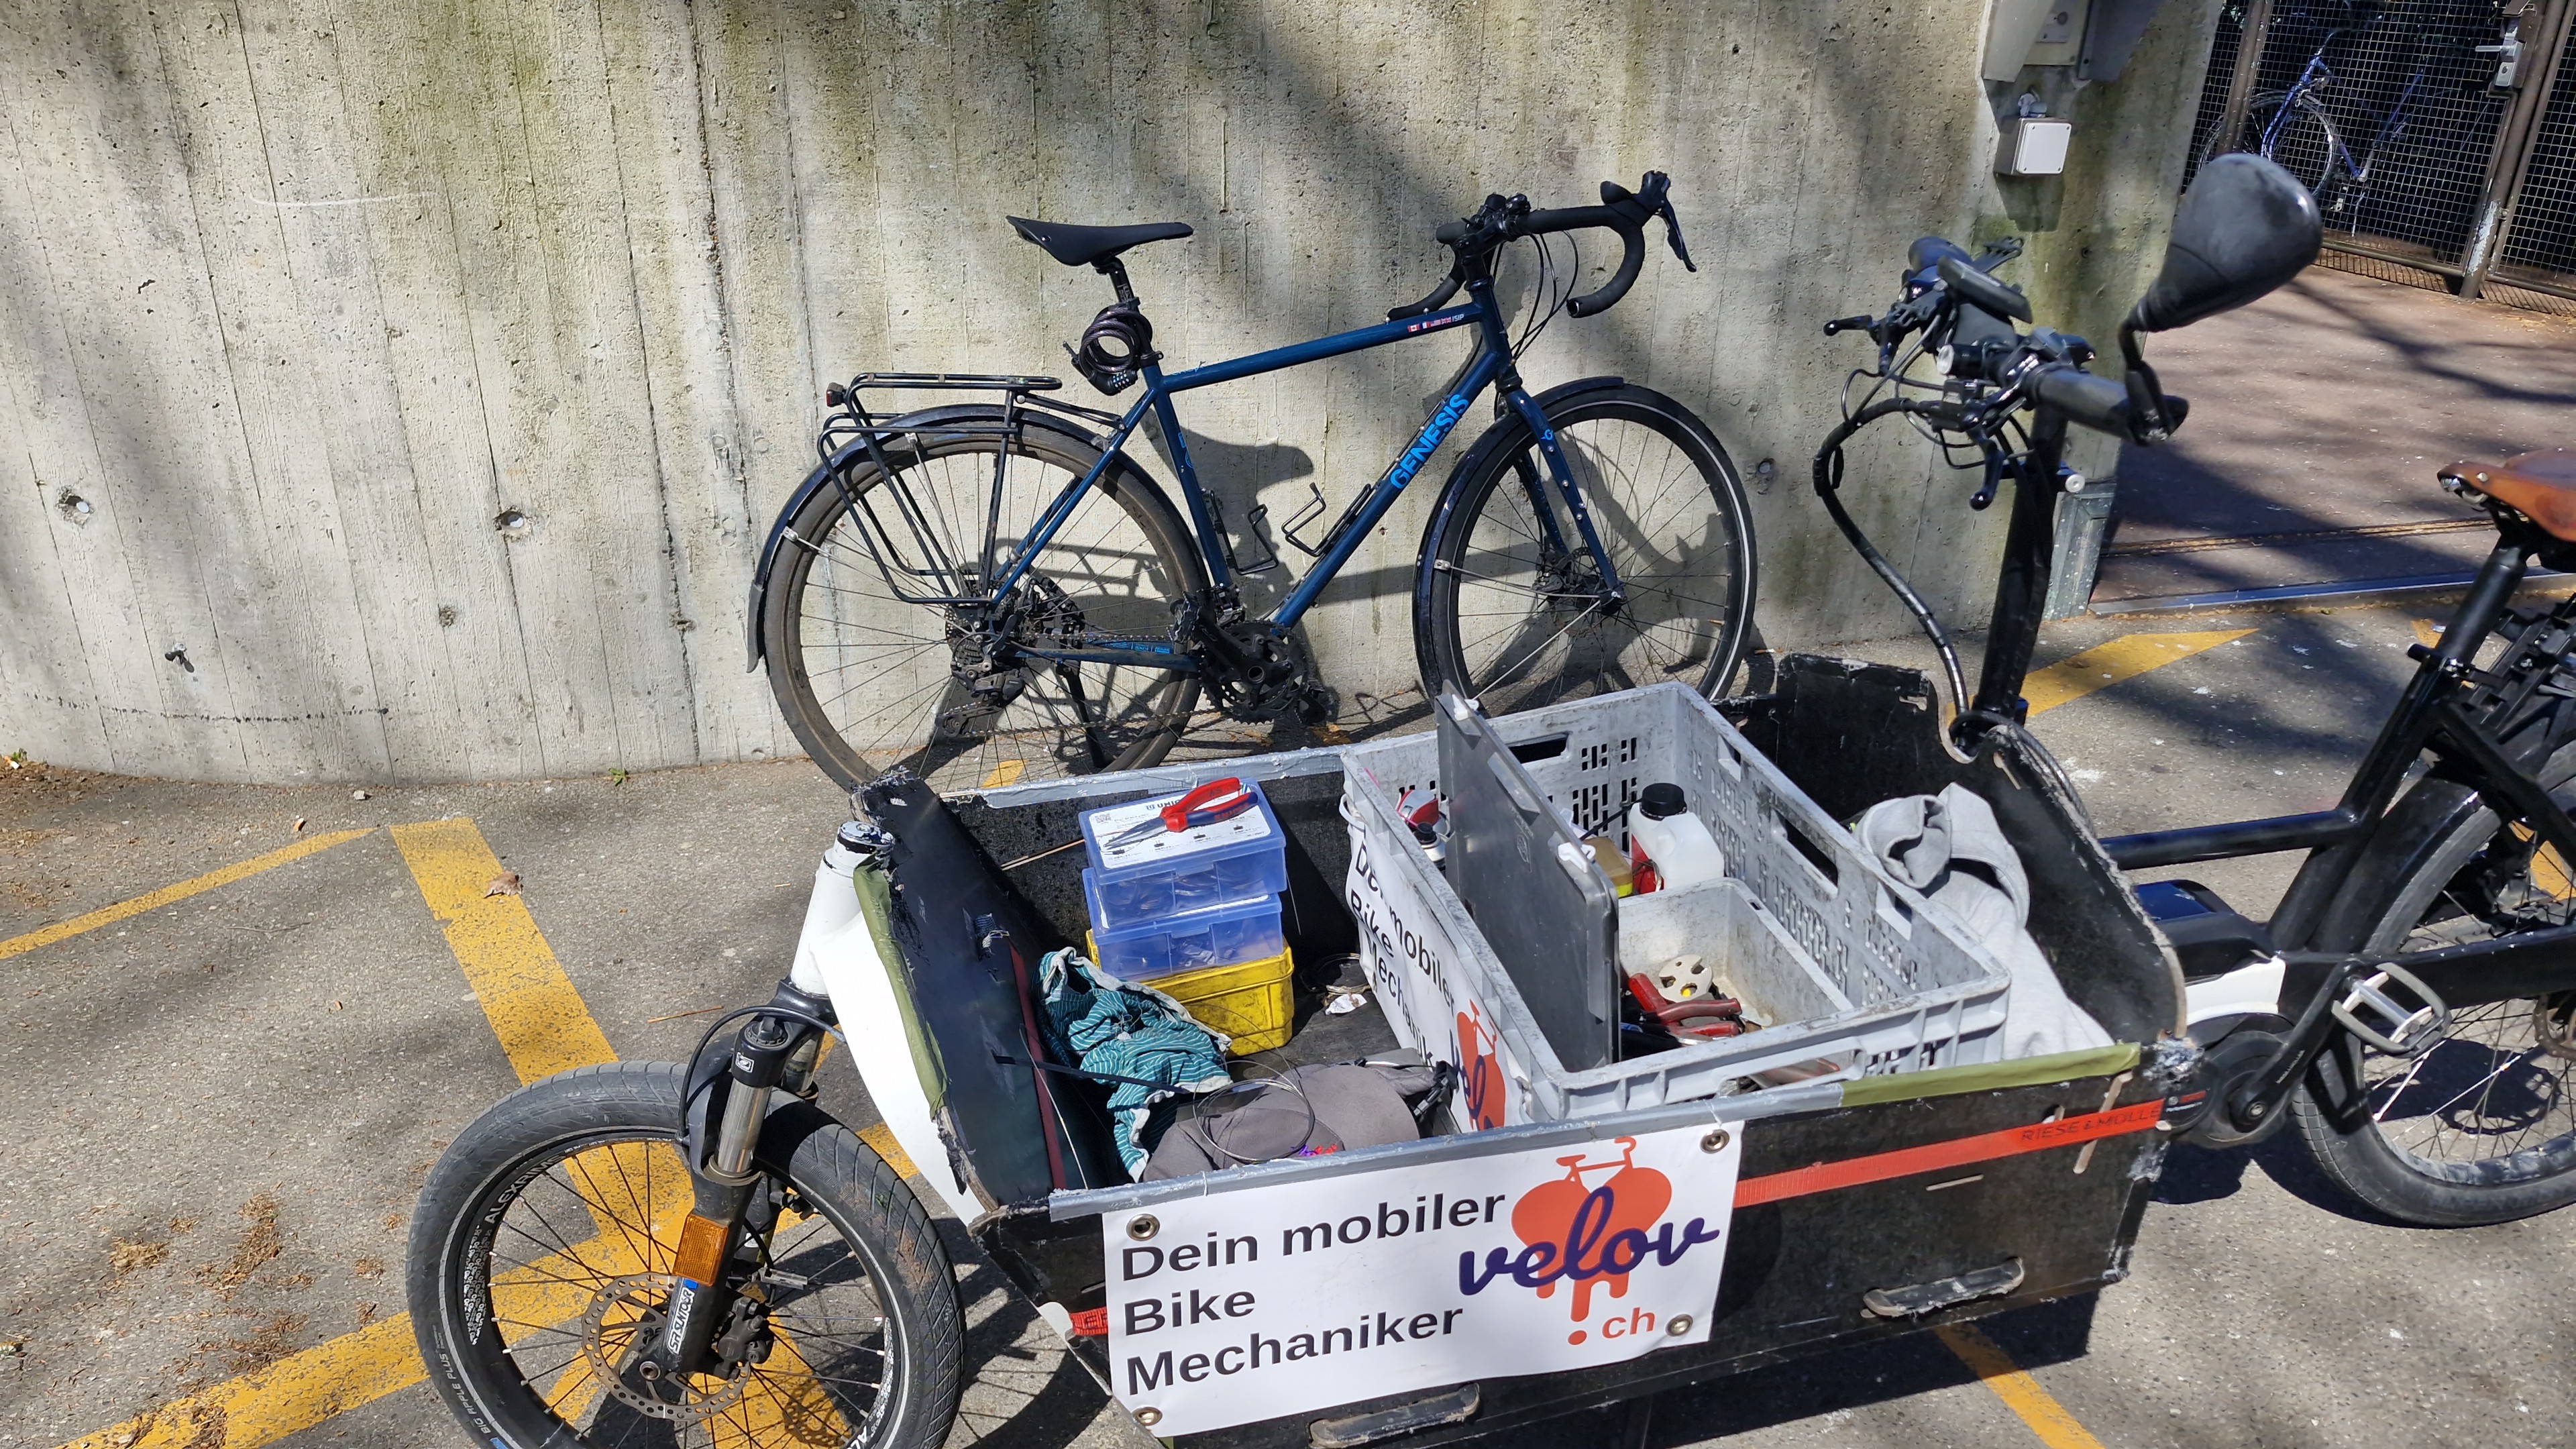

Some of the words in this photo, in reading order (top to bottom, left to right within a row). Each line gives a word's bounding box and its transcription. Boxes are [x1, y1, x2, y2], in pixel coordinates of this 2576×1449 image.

[1390, 394, 1469, 489] GENESIS
[1364, 928, 1435, 1073] Mechanik
[1389, 904, 1456, 1018] mobiler
[2021, 1120, 2080, 1142] RIESE
[484, 1154, 566, 1225] ALEXRIMS
[1122, 1231, 1258, 1282] Dein
[1282, 1192, 1506, 1256] mobiler
[1458, 1186, 1720, 1297] velov
[1124, 1289, 1256, 1337] Bike
[1127, 1307, 1464, 1395] Mechaniker
[439, 1352, 458, 1380] PLUS
[451, 1383, 477, 1415] APPLE
[473, 1417, 492, 1434] BIG
